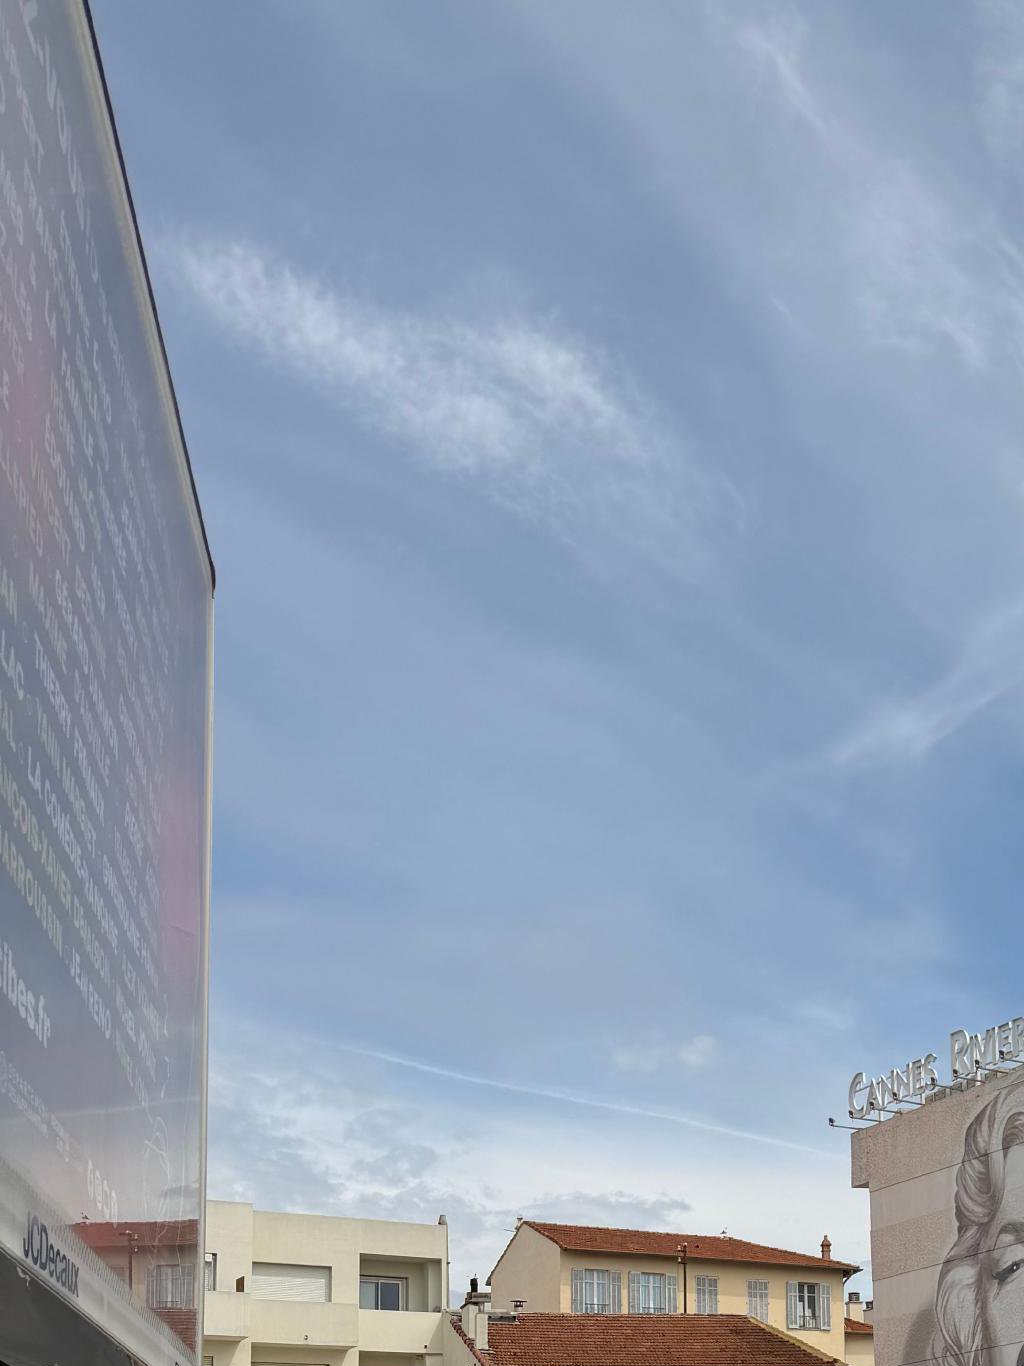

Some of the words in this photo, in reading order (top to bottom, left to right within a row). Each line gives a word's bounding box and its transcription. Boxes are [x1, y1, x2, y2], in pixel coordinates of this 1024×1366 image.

[28, 745, 41, 799] LA
[849, 1053, 938, 1118] CANNES
[22, 1209, 80, 1298] JCDecaux
